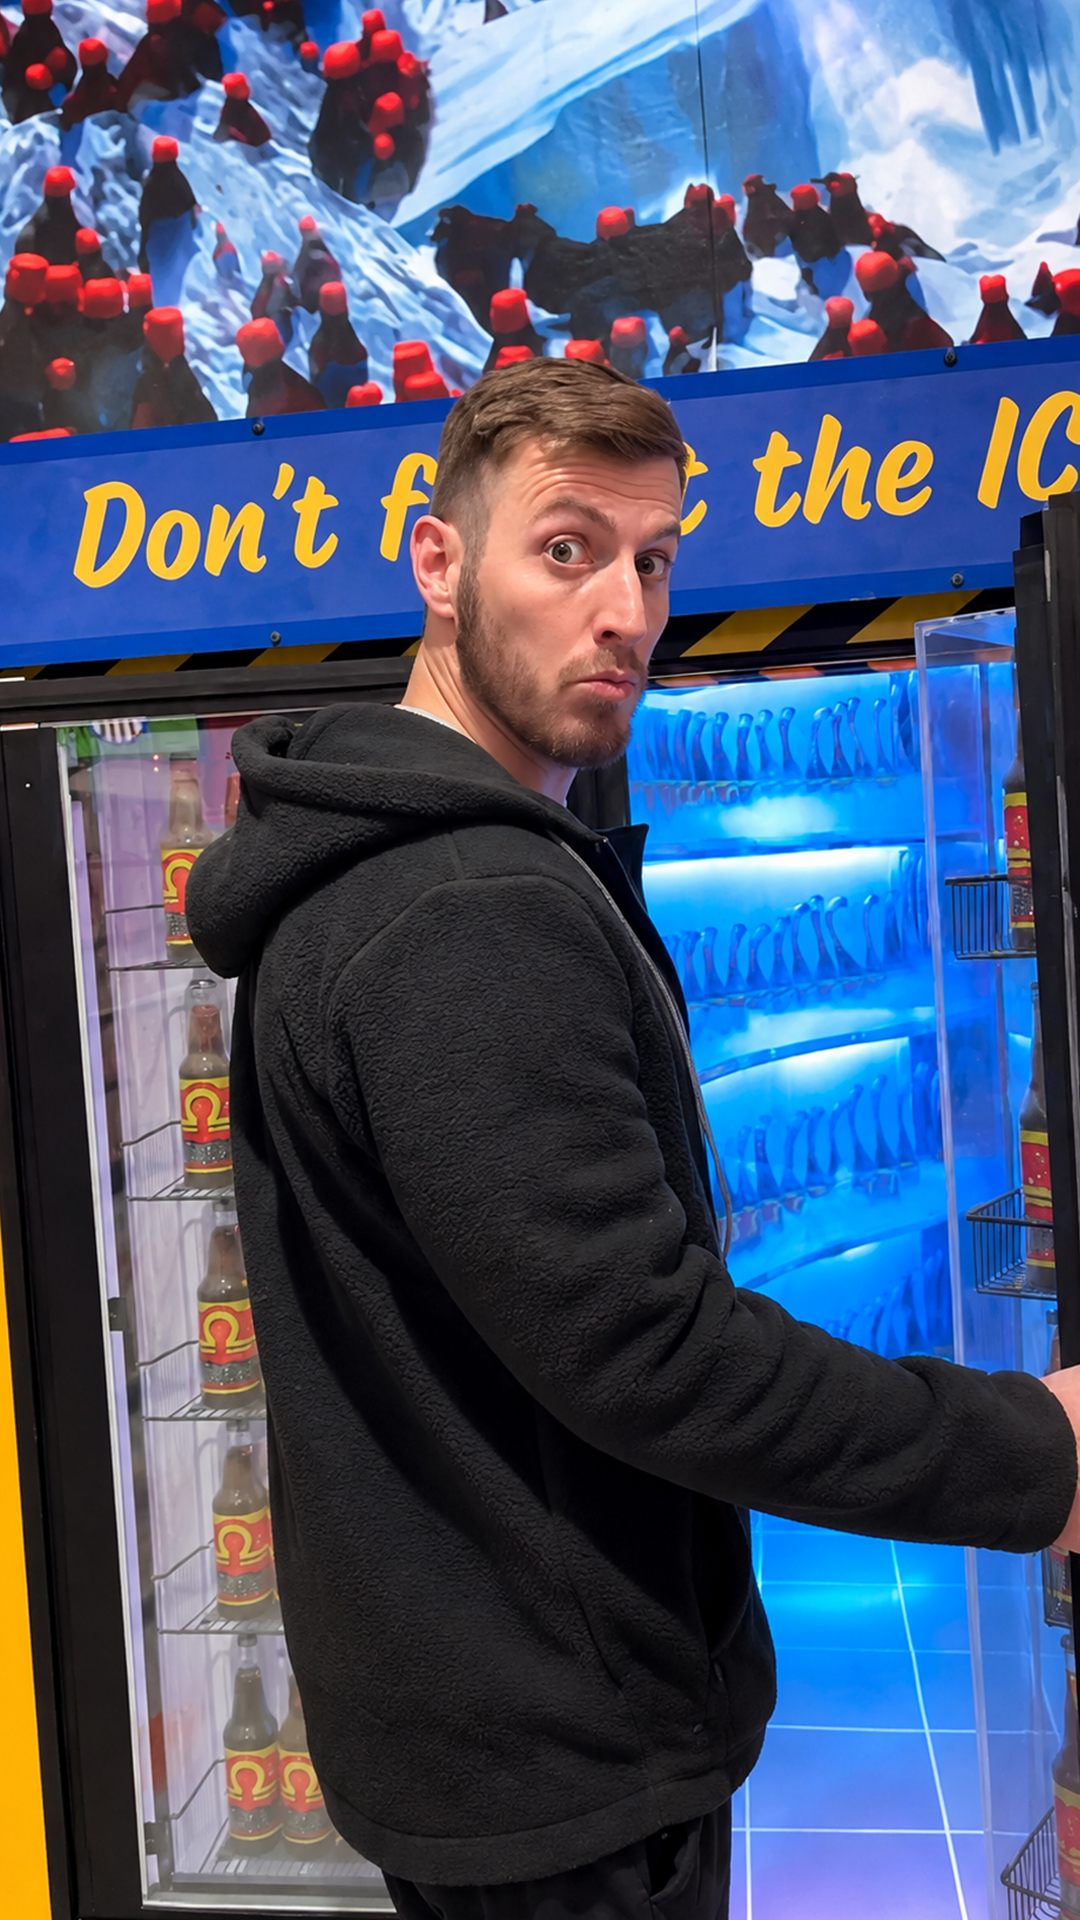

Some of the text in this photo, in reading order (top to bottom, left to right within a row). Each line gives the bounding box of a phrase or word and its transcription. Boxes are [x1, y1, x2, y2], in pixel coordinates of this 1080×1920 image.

[74, 463, 338, 588] Don't
[752, 414, 934, 527] the
[977, 390, 1080, 509] IC
